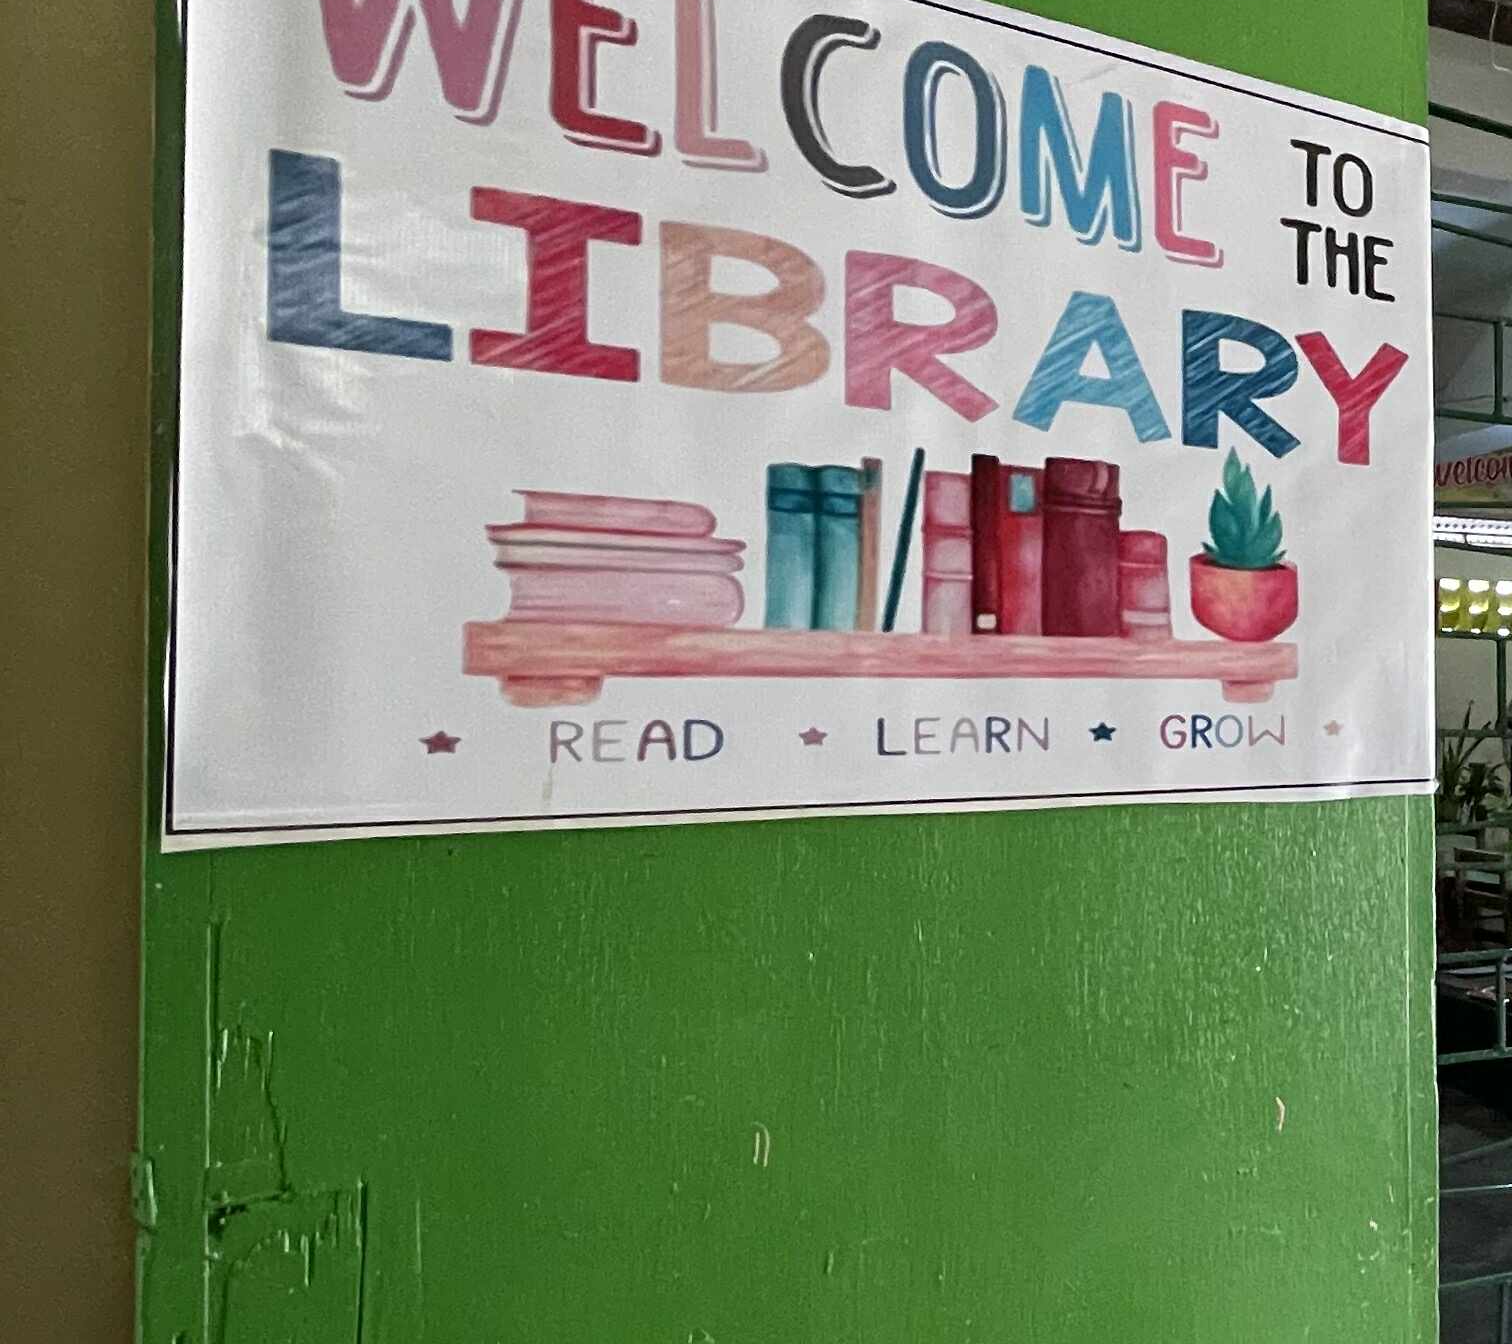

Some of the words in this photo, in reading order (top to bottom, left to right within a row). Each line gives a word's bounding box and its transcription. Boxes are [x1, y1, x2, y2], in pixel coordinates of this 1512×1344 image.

[1290, 139, 1373, 217] TO
[1280, 218, 1395, 302] THE
[266, 147, 1410, 467] LIBRARY
[548, 719, 724, 764] READ
[877, 716, 1050, 756] LEARN
[1160, 714, 1287, 753] GROW
